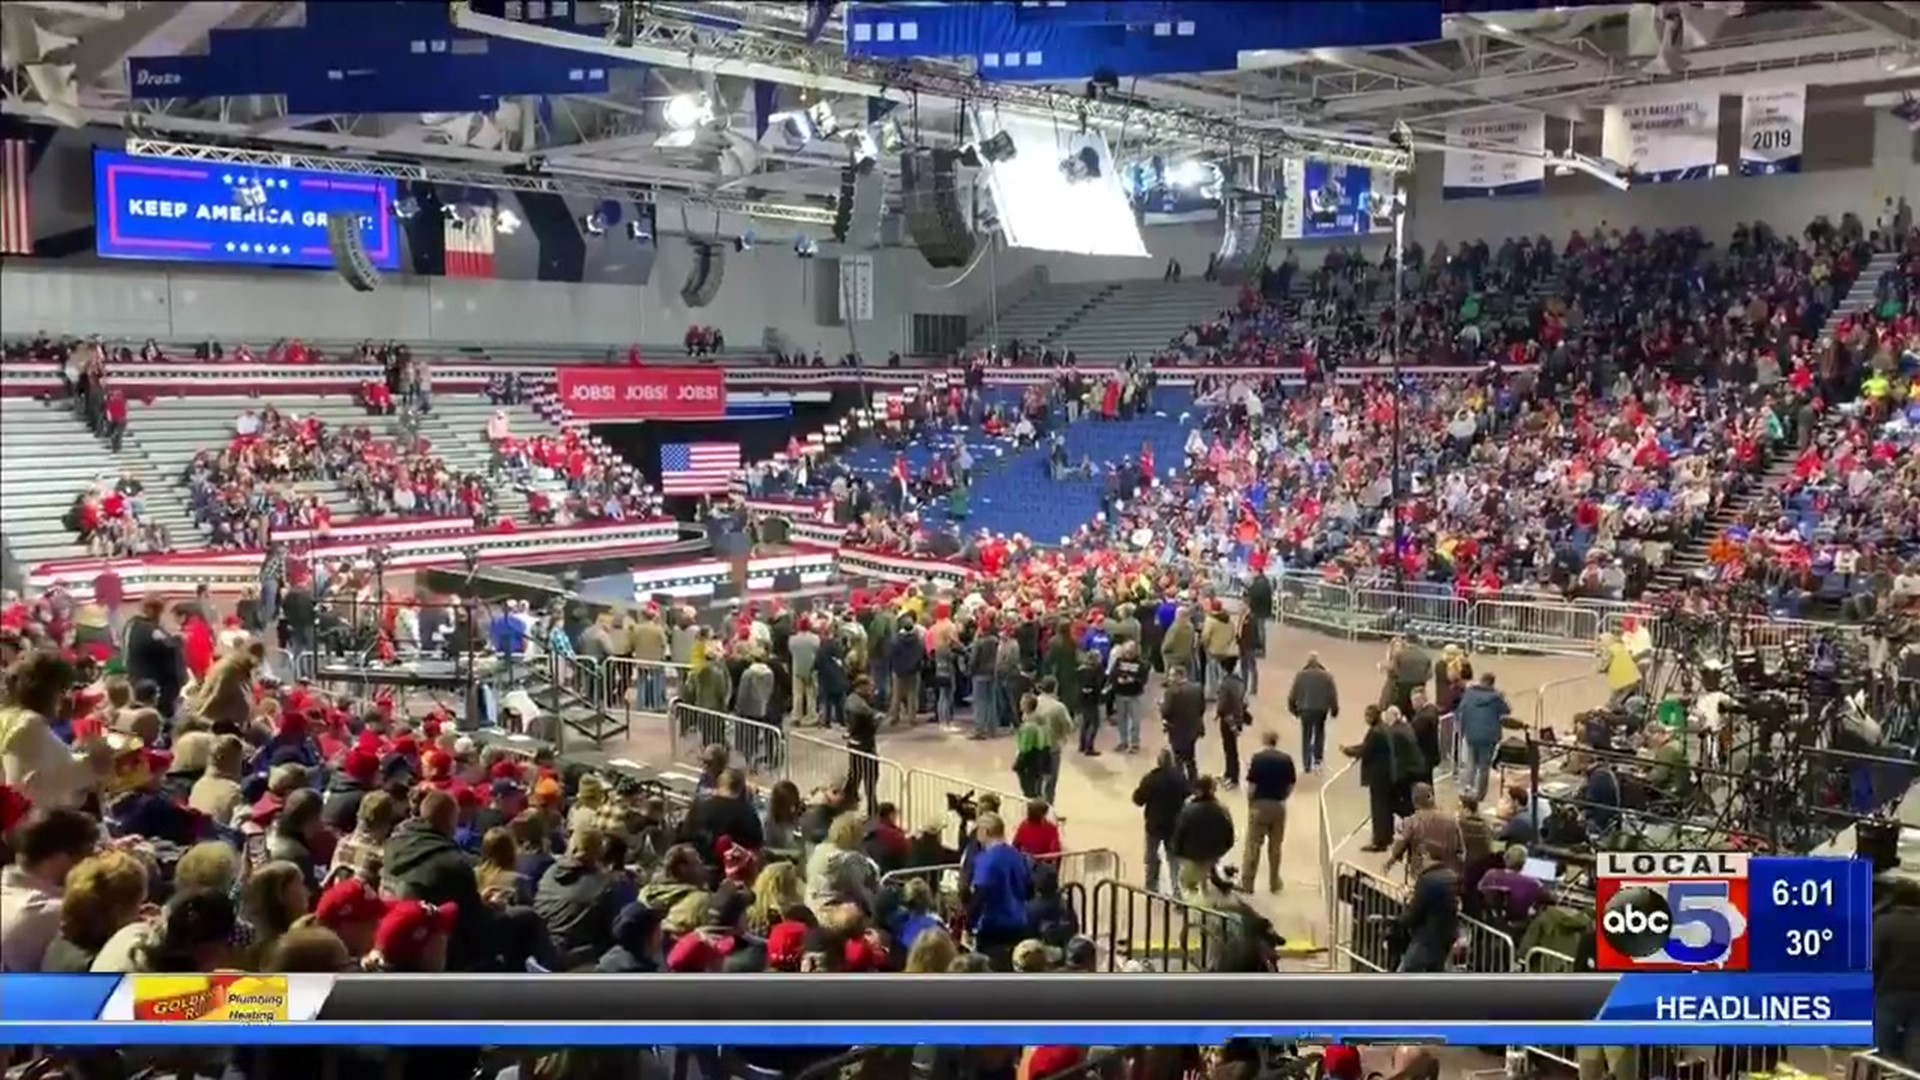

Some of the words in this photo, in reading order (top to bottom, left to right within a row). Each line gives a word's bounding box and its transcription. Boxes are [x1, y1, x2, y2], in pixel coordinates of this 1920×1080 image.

[1753, 129, 1791, 149] 2019
[129, 199, 187, 218] KEEP
[196, 204, 294, 225] AMERICA
[302, 210, 373, 231] GRT!
[569, 384, 616, 400] JOBS!
[624, 384, 668, 400] JOBS!
[677, 386, 718, 400] JOBS!
